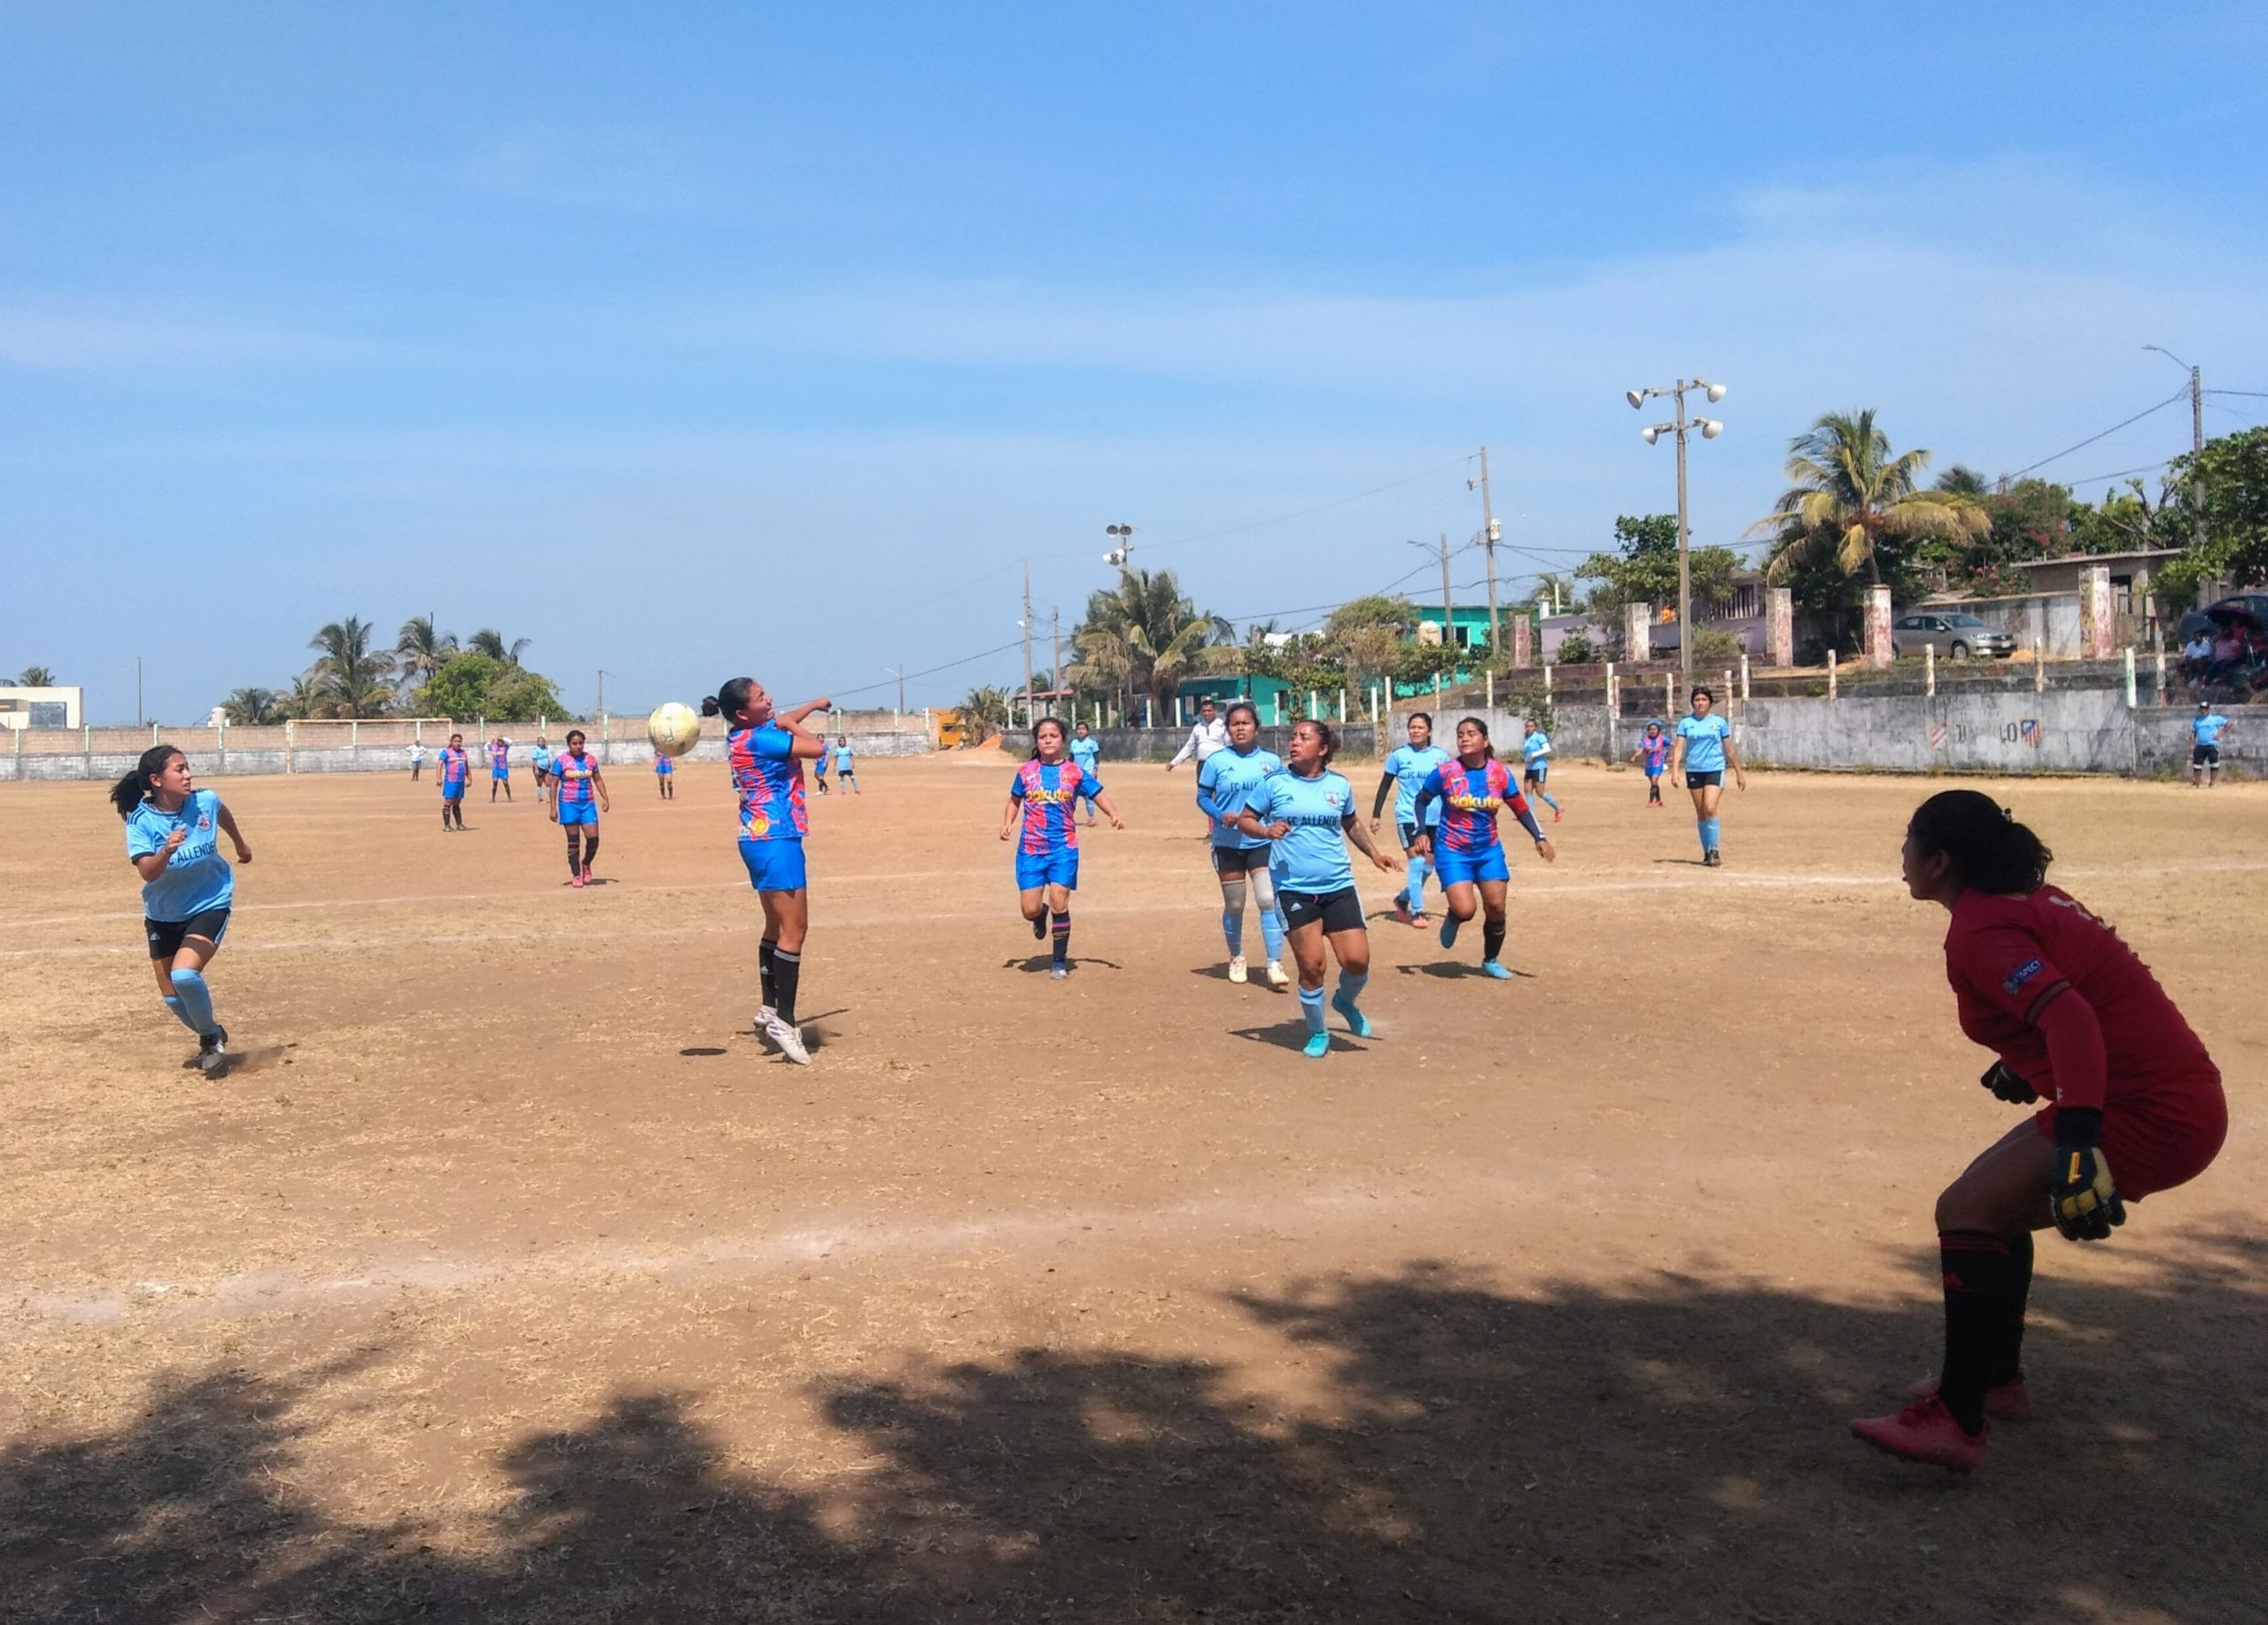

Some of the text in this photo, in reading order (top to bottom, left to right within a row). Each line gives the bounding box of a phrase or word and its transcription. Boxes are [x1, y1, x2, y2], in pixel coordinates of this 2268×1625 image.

[1230, 782, 1239, 791] FC
[1286, 815, 1299, 827] FC
[177, 841, 214, 863] ALLENDE
